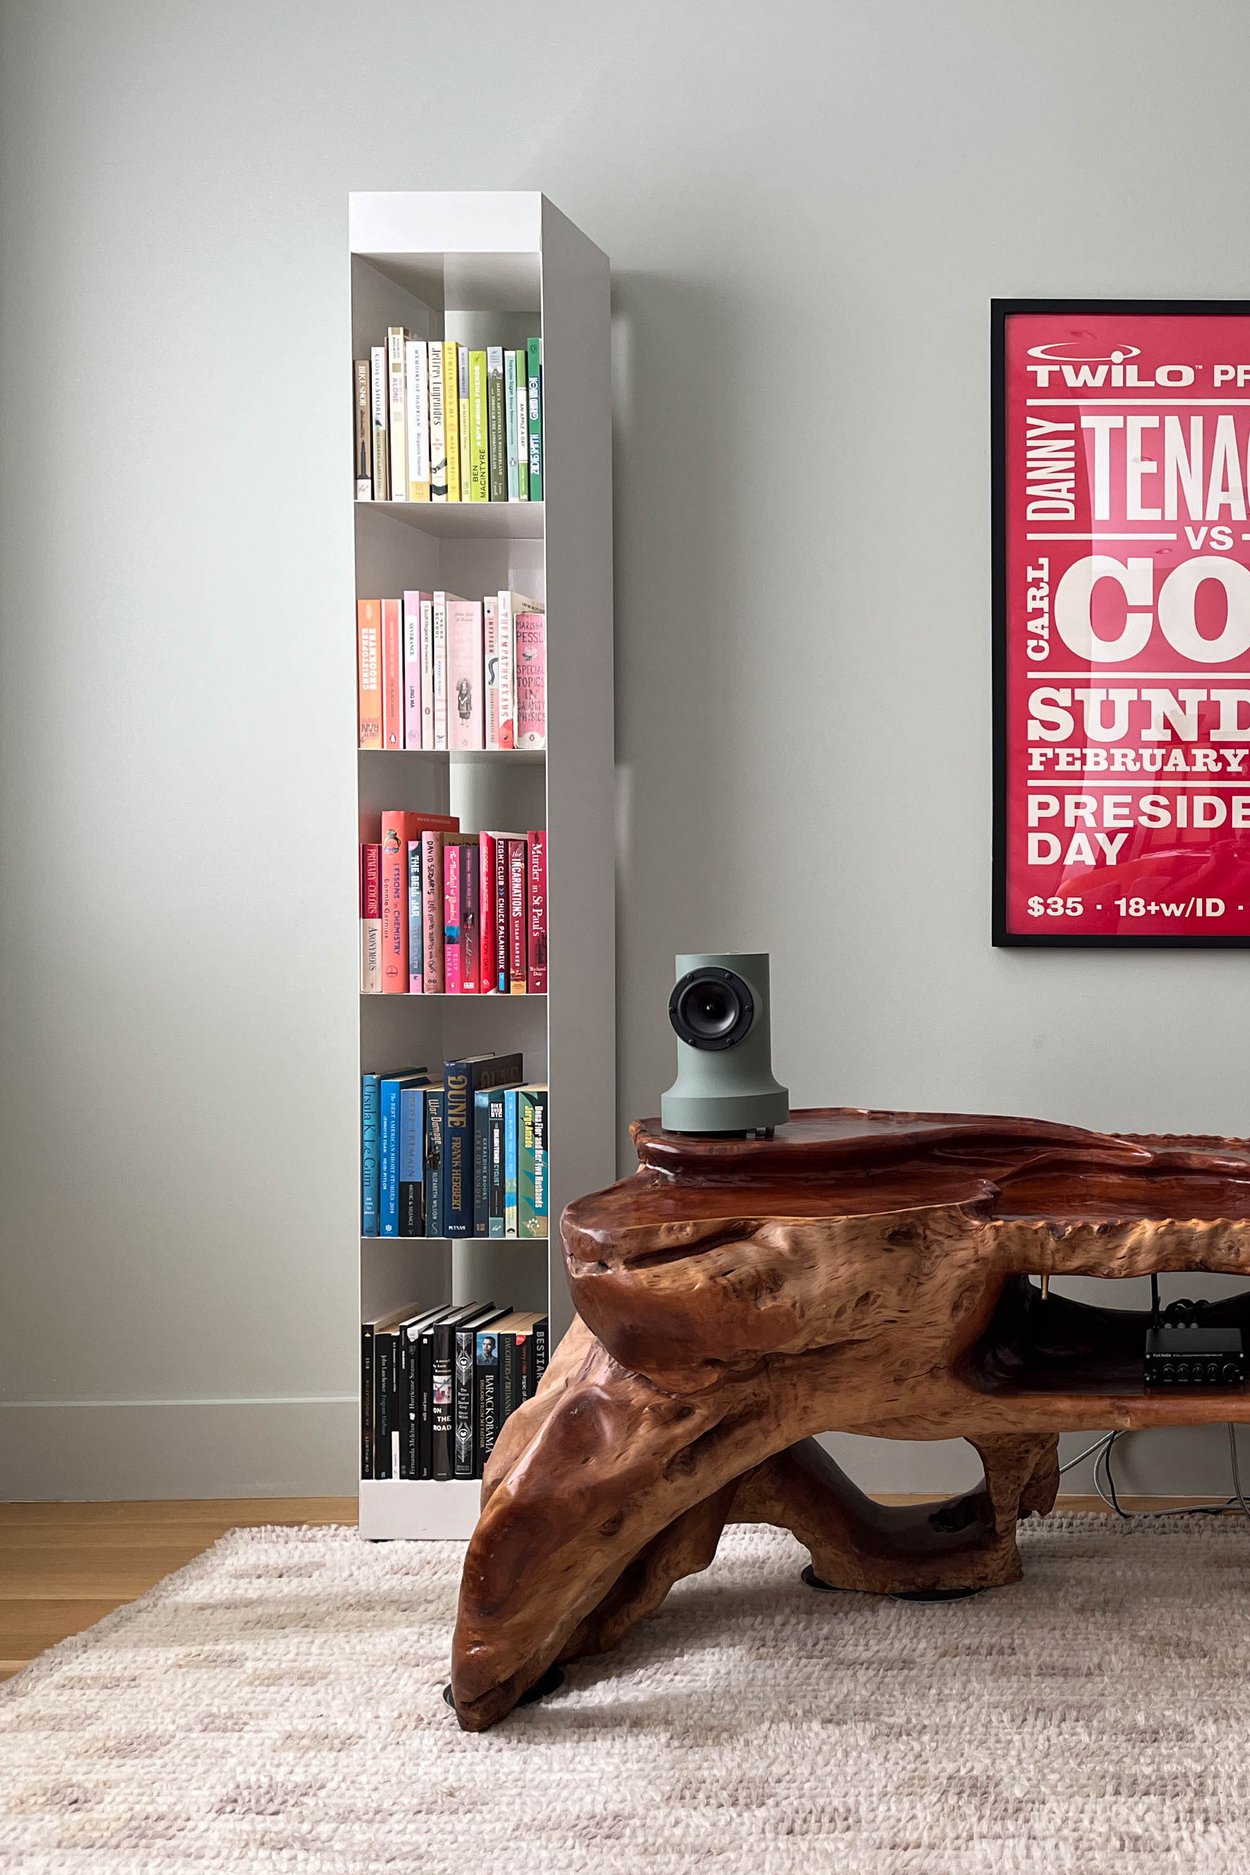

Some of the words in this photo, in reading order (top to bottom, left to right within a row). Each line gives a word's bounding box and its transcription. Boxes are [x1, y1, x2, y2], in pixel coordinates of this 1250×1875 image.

[1026, 416, 1076, 521] DANNY
[1184, 525, 1234, 551] VS
[1026, 557, 1050, 662] CARL
[1027, 747, 1249, 773] FEBRUARY
[427, 841, 435, 863] DAVID
[531, 843, 542, 882] Murder
[1027, 832, 1129, 866] DAY
[367, 849, 377, 880] PRIMARY
[411, 855, 420, 874] THE
[367, 885, 377, 914] COLORS
[411, 875, 420, 897] BELL
[512, 858, 523, 917] INCARNATIONS
[532, 885, 541, 893] in
[532, 895, 543, 906] St
[411, 900, 420, 918] JAR
[1027, 895, 1084, 918] $35
[1114, 897, 1226, 917] 18+w/ID
[532, 908, 545, 937] Paul's
[364, 1084, 376, 1122] Ursula
[447, 1075, 468, 1128] DUNE
[364, 1139, 376, 1155] Le
[451, 1136, 462, 1168] FRANK
[364, 1157, 376, 1187] Guin
[451, 1169, 462, 1212] HERBERT
[535, 1331, 545, 1385] BESTIAR
[485, 1374, 495, 1415] BARACK
[485, 1415, 495, 1453] OBAMA
